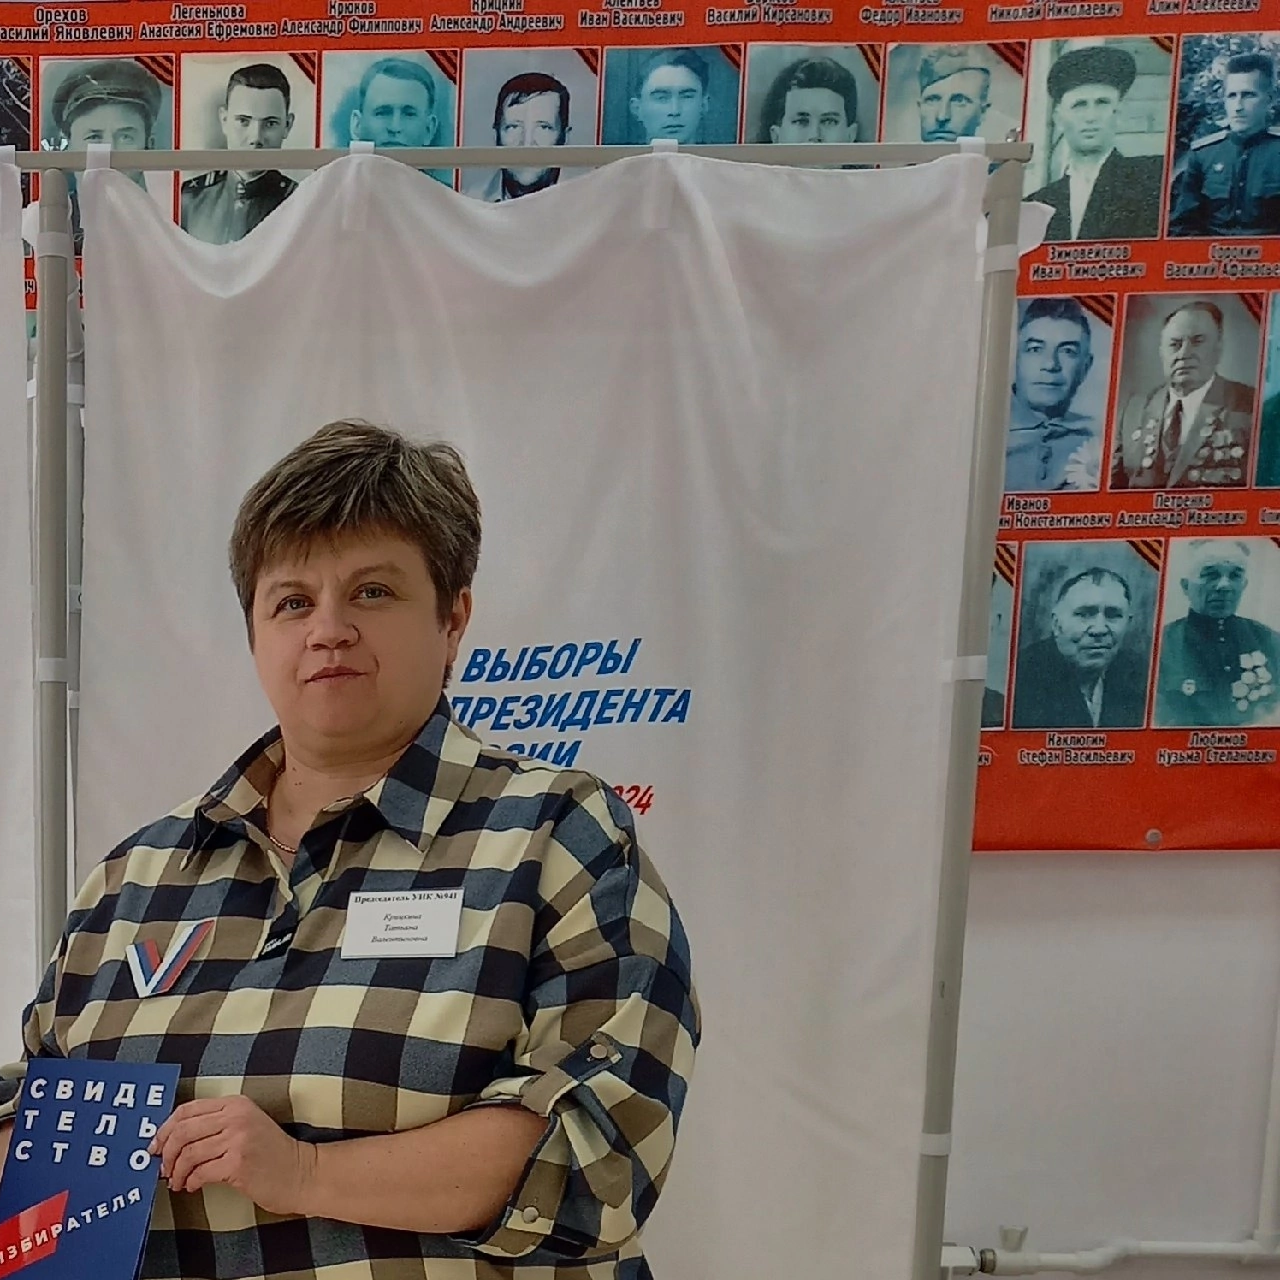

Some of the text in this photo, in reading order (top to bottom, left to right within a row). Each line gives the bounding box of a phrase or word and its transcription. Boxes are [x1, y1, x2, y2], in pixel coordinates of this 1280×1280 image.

[36, 7, 88, 24] Орехов
[173, 4, 246, 20] Легенькова
[328, 0, 375, 17] Крюков
[707, 8, 832, 26] Василий Кирсанович
[860, 9, 962, 25] Федор Иванович
[989, 2, 1122, 21] Николай Николаевич
[281, 17, 422, 36] Александр Филиппович
[430, 14, 562, 32] Александр Андреевич
[579, 10, 683, 26] Иван Васильевич
[54, 24, 133, 41] Яковлевич
[139, 21, 276, 40] Анастасия Ефремовна
[1031, 264, 1144, 281] Иван Тимофеевич
[1166, 264, 1218, 278] Василий
[1006, 497, 1050, 511] Иванов
[1015, 513, 1111, 528] Константинович
[1117, 511, 1182, 528] Александр
[1187, 511, 1246, 525] Иванович
[460, 637, 642, 683] ВЫБОРЫ
[452, 688, 692, 732] ПРЕЗИДЕНТА
[1189, 732, 1248, 747] Любимов
[1019, 749, 1135, 765] Стефан Васильевич
[1158, 749, 1275, 765] Кузьма Степанович
[29, 1077, 166, 1108] СВИДЕ
[23, 1109, 158, 1139] ТЕЛЬ
[14, 1140, 151, 1172] СТВО
